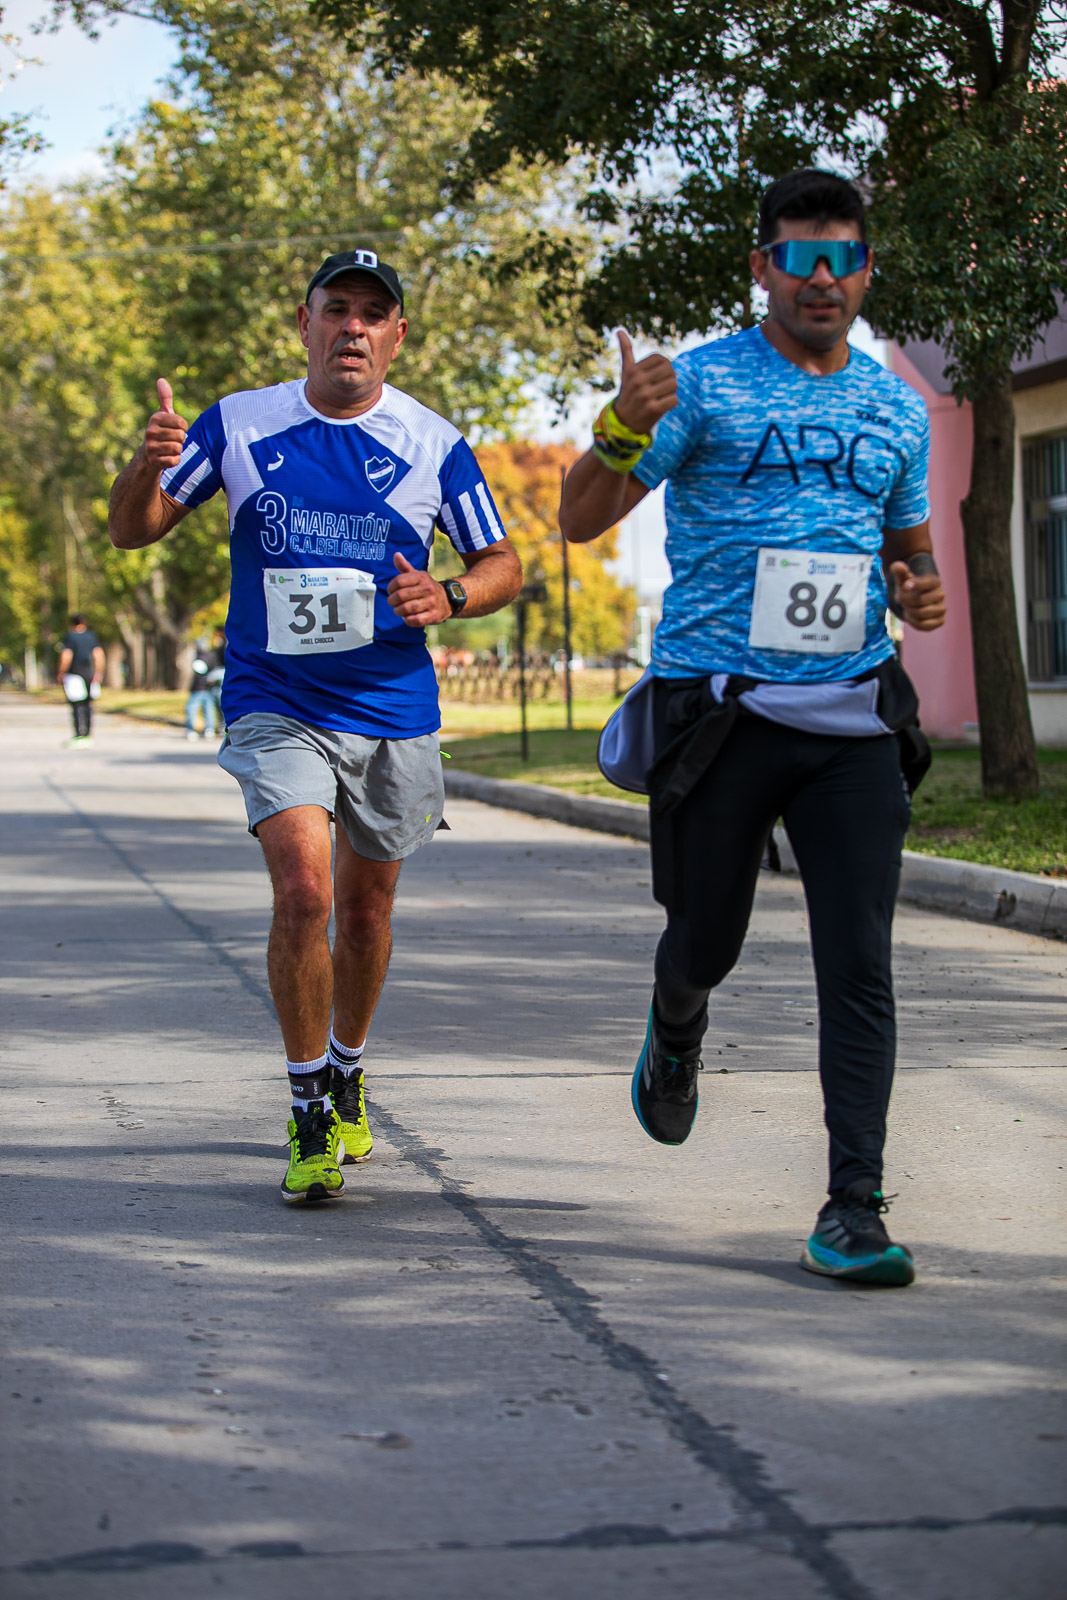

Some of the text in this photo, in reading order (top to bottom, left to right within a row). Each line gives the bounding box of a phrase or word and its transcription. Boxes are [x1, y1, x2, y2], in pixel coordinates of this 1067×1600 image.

[354, 248, 378, 269] D
[738, 422, 902, 499] ARG
[256, 491, 287, 556] 3
[290, 508, 391, 543] MARATÓN
[288, 592, 347, 635] 31
[785, 581, 847, 630] 86
